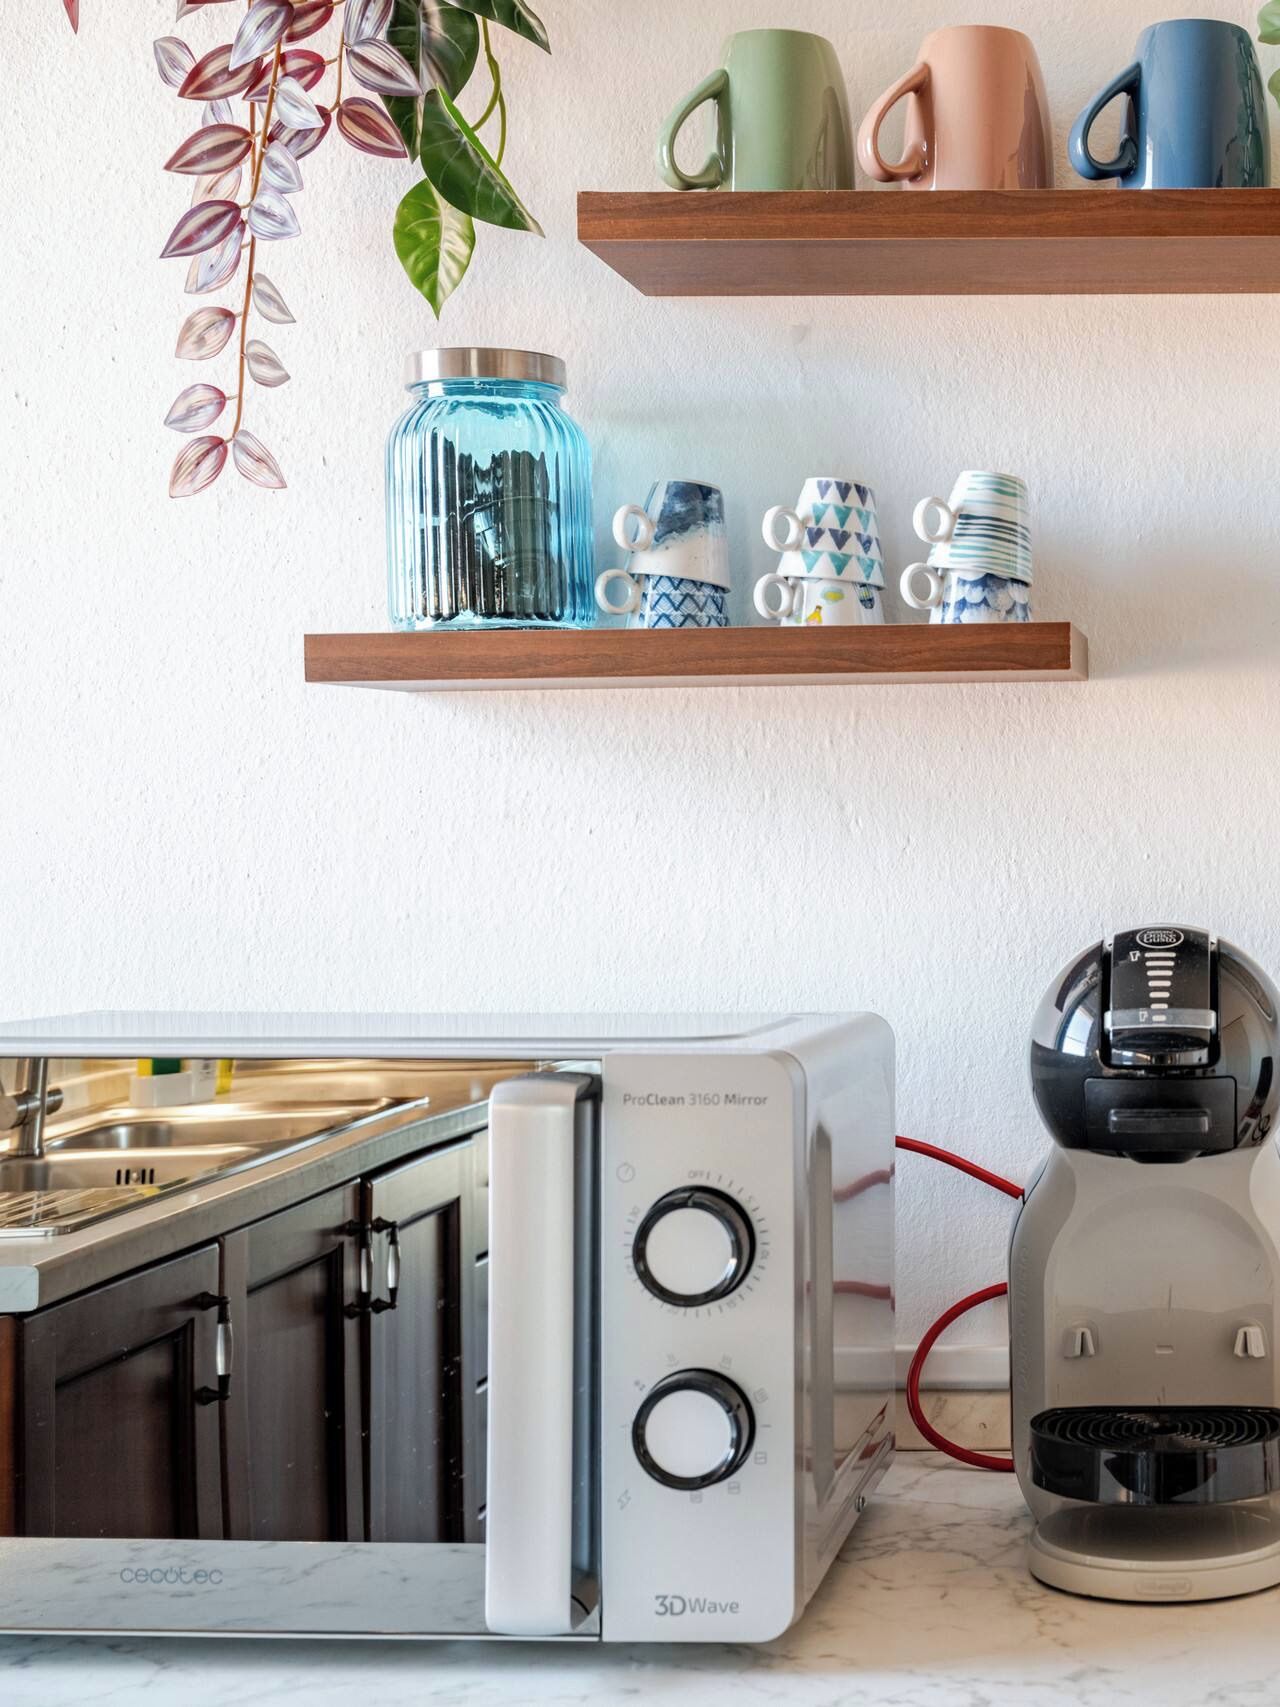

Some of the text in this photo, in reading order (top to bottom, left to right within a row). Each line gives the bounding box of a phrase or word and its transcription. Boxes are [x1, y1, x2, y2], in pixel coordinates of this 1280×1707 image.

[622, 1093, 768, 1106] ProClean 3160 Mirror
[120, 1566, 223, 1584] cecotec
